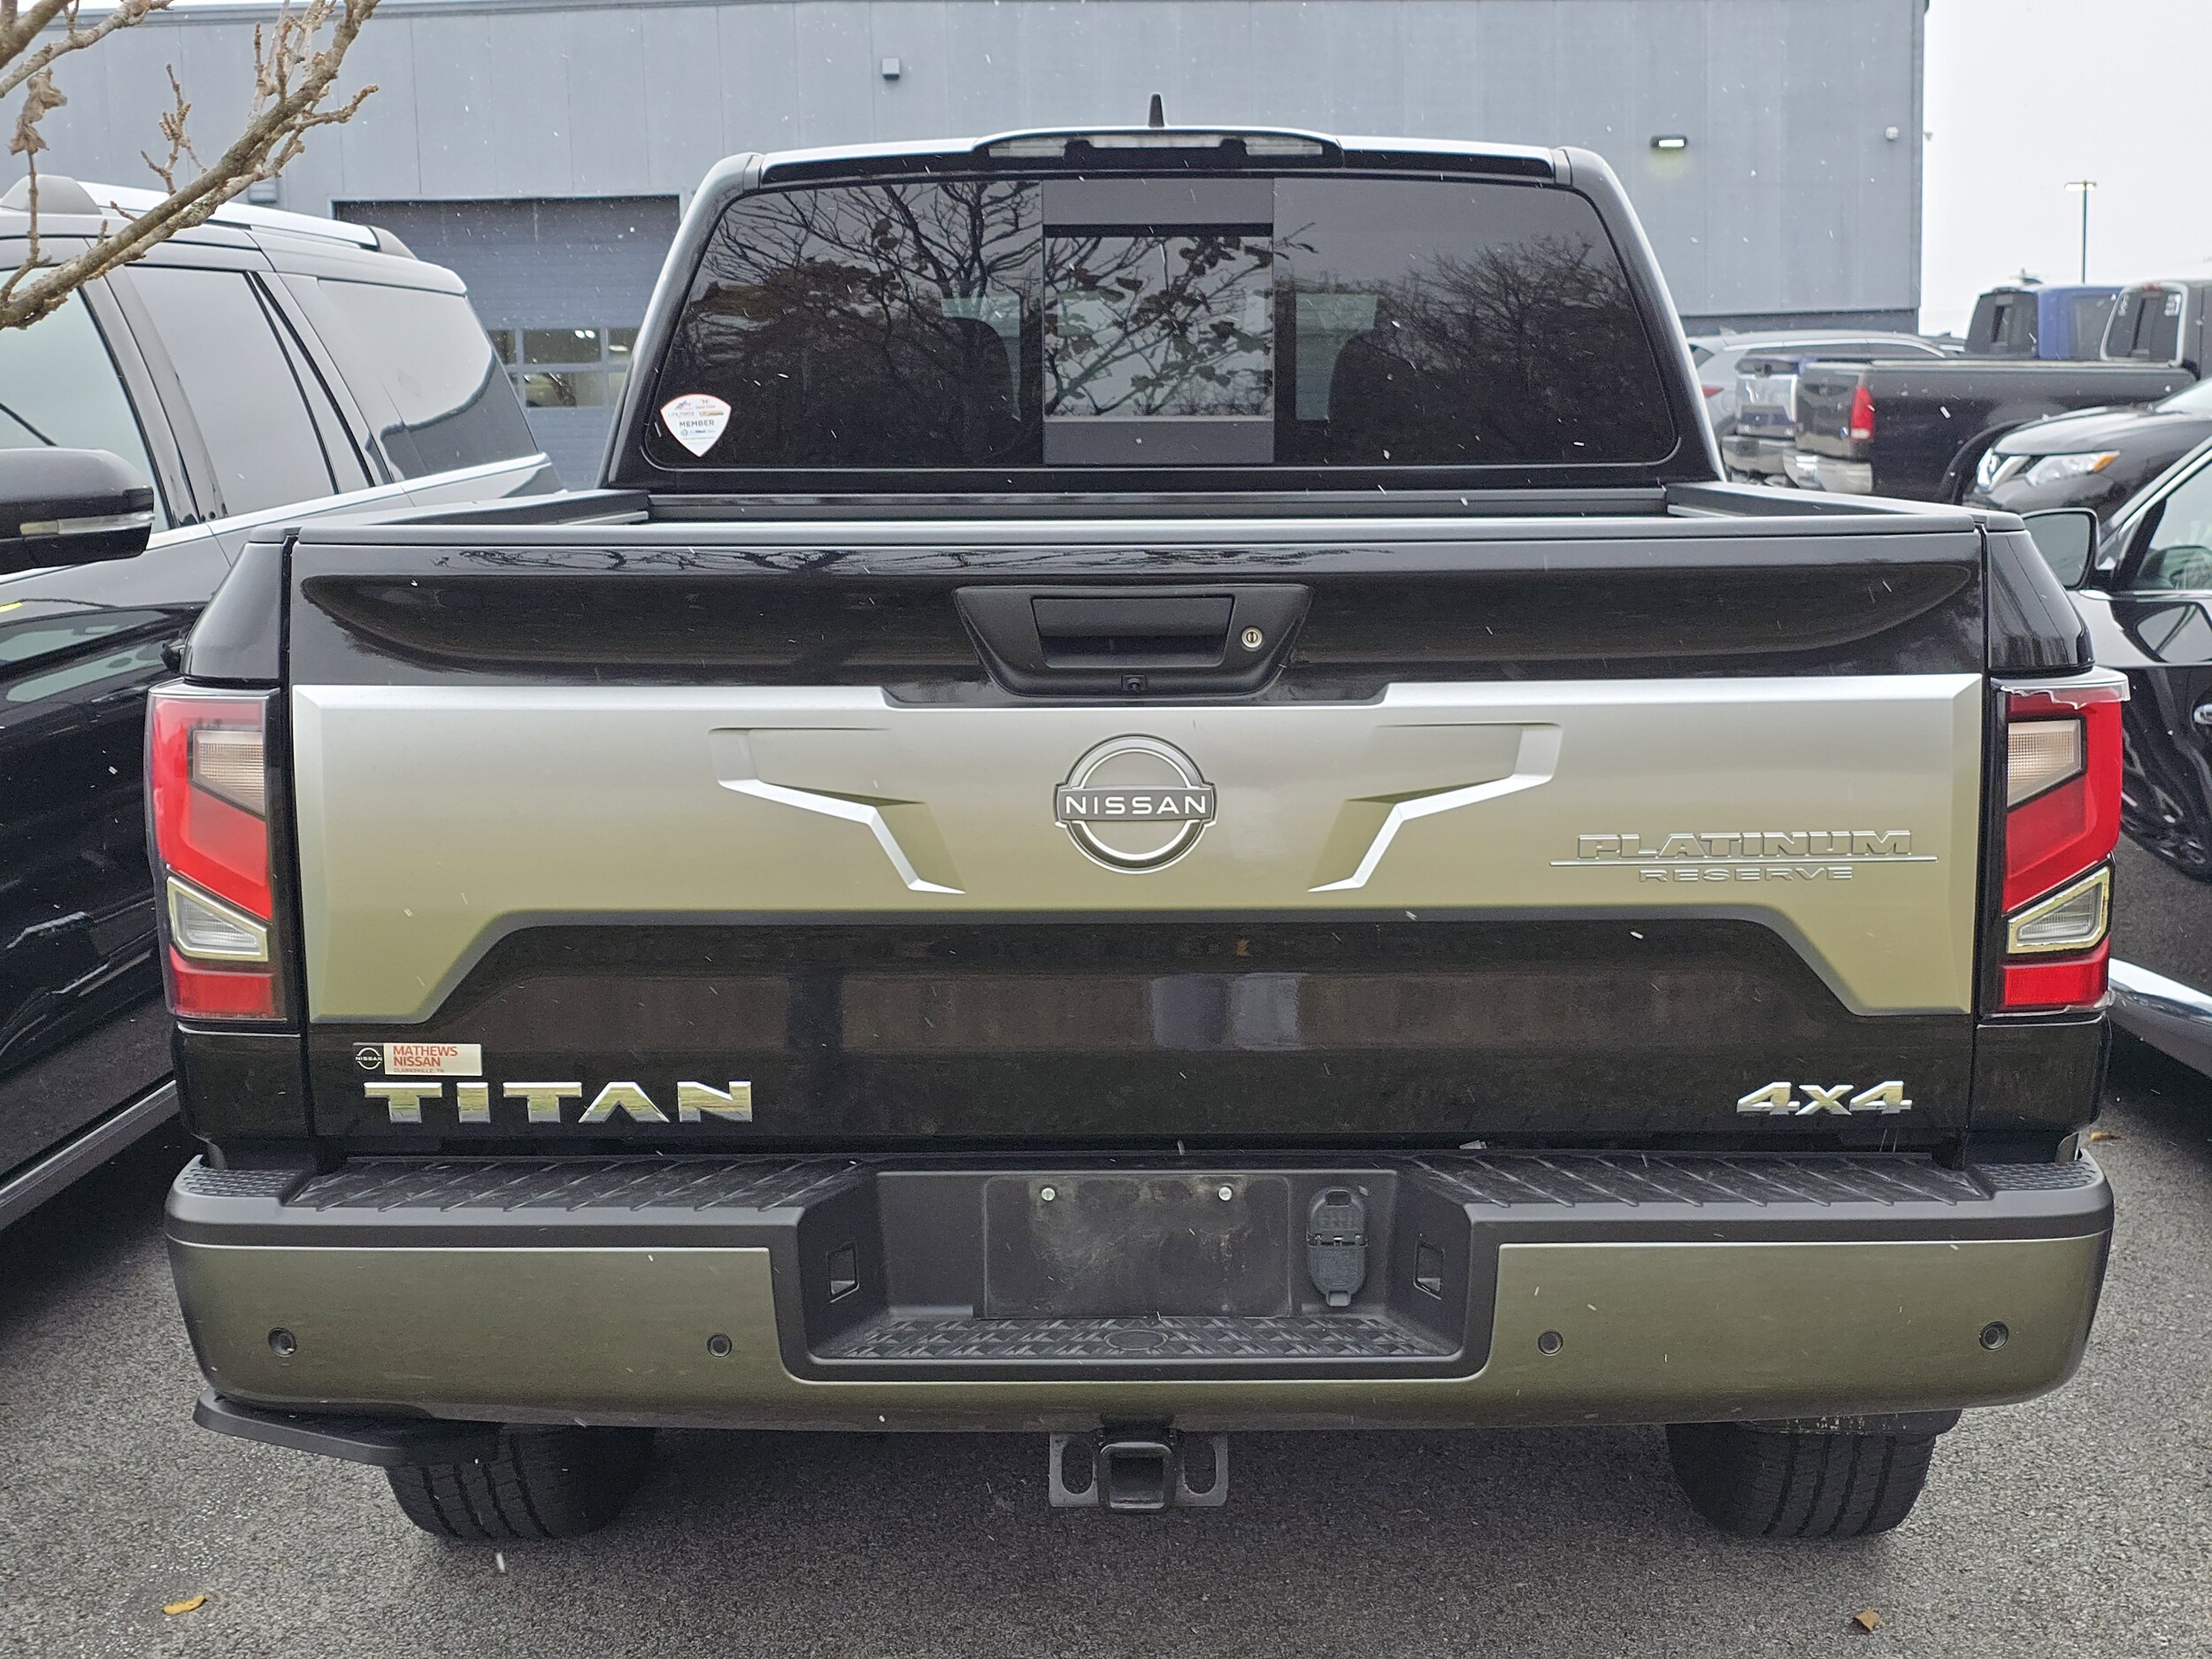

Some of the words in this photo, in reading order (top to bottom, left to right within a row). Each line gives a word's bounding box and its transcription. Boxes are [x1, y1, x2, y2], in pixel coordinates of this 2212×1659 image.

[1065, 795, 1206, 814] NISSAN
[1576, 830, 1912, 860] PLATINUM
[1639, 865, 1854, 883] RESERVE
[393, 1046, 458, 1056] MATHEWS
[394, 1056, 441, 1066] NISSAN
[364, 1080, 753, 1124] TITAN
